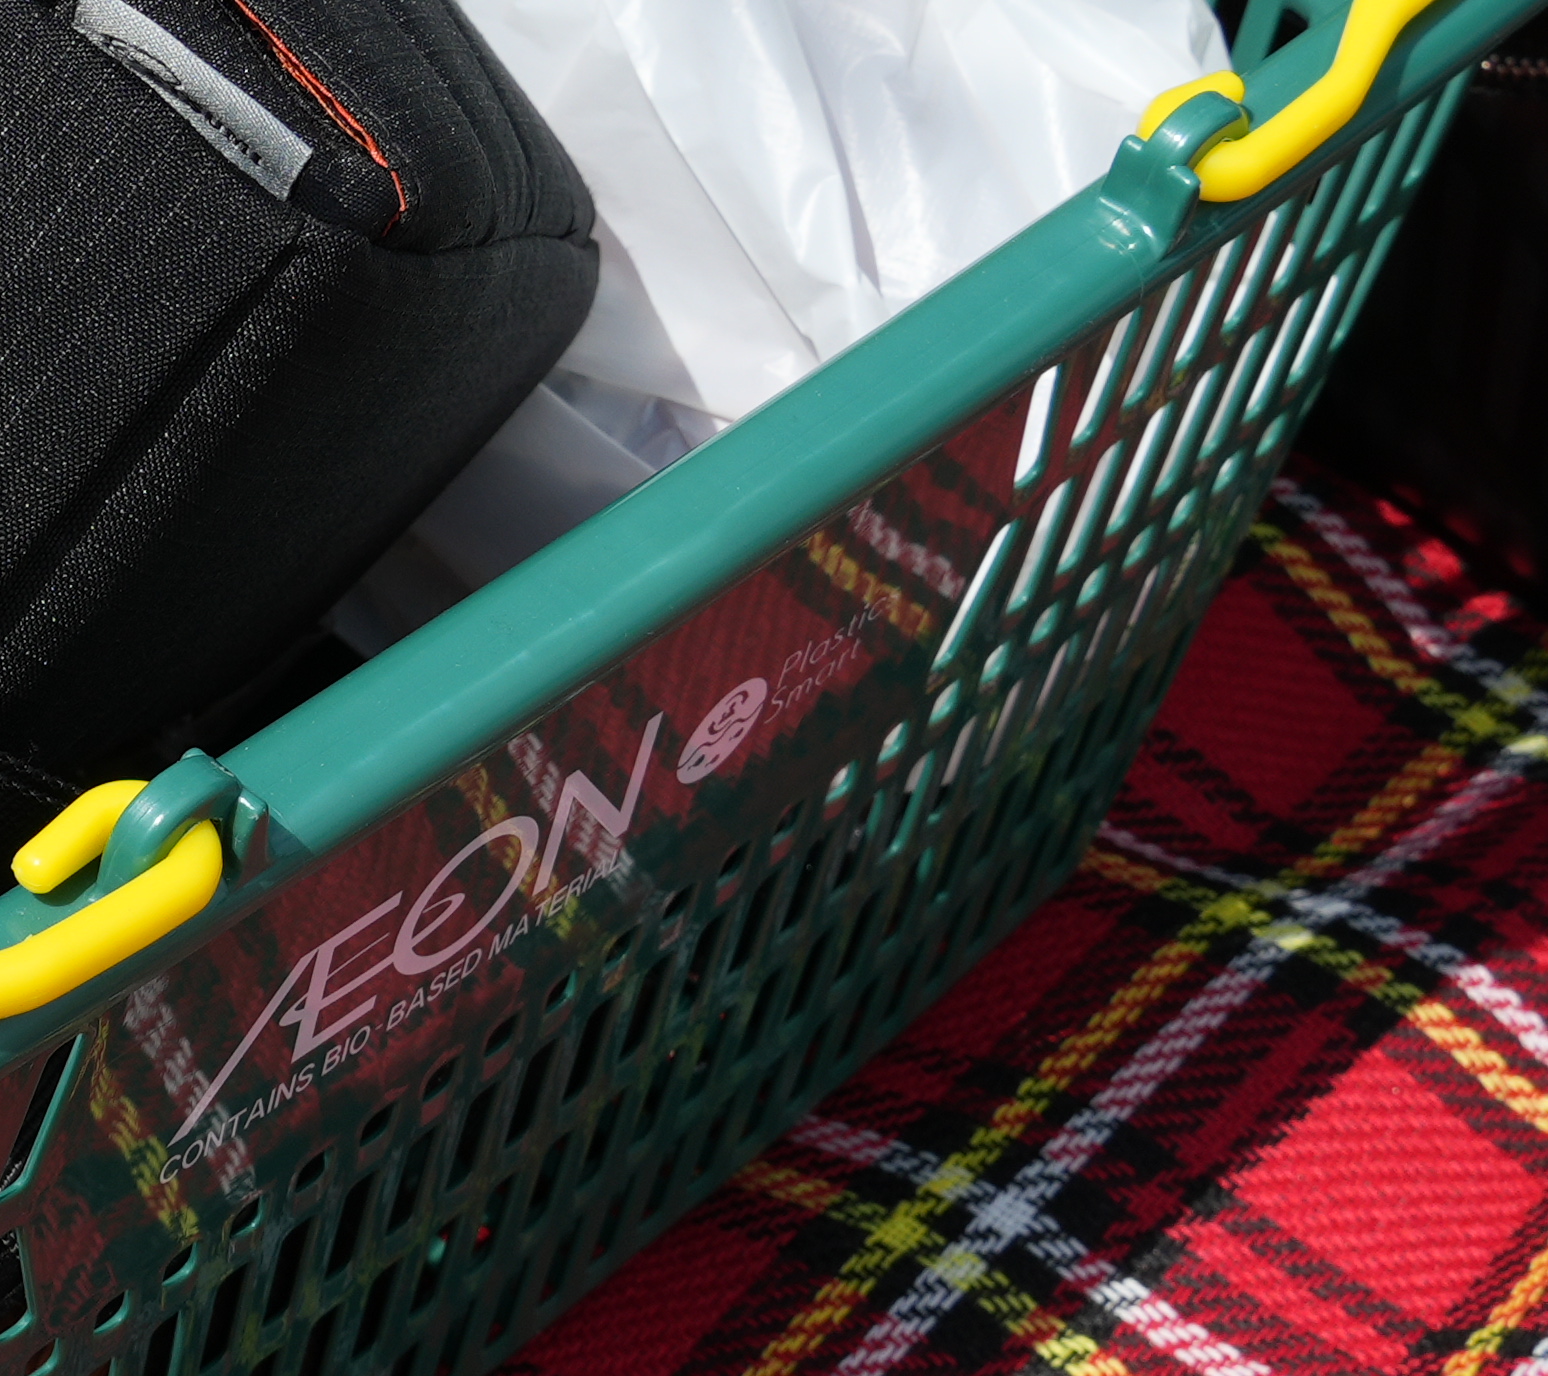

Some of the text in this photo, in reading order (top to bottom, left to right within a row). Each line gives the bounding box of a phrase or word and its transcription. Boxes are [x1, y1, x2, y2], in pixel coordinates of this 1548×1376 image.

[763, 637, 863, 724] Smart
[776, 594, 901, 689] Plastic
[159, 1063, 314, 1185] CONTAINS
[487, 853, 632, 962] MATERIAL
